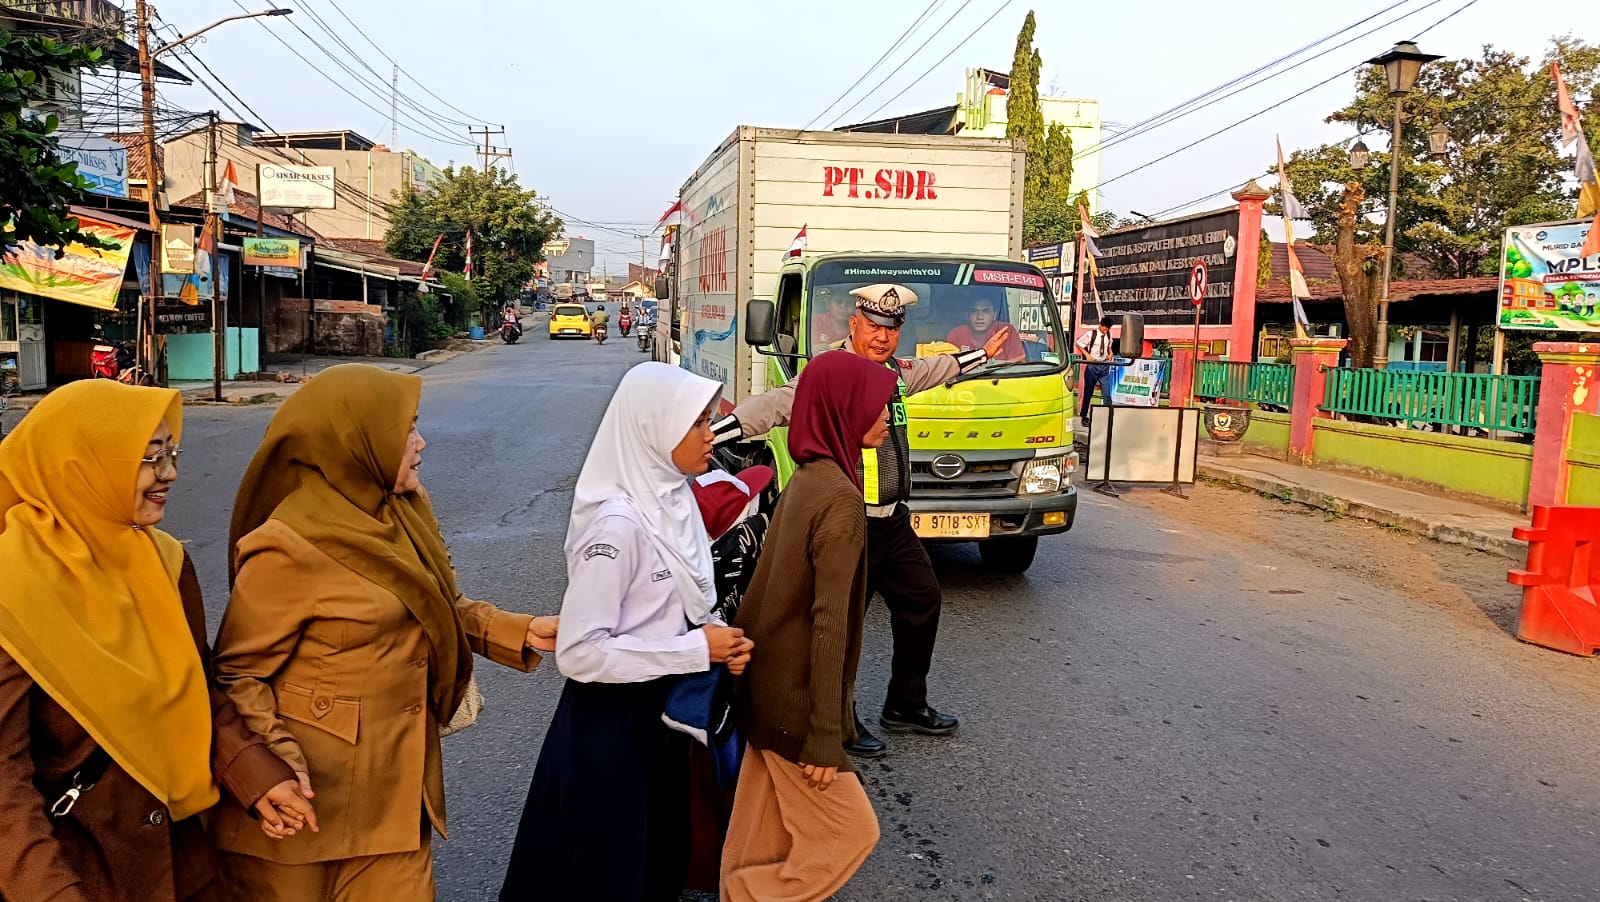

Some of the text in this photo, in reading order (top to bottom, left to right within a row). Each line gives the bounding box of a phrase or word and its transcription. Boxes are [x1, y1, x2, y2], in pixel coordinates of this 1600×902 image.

[822, 166, 938, 200] PT.SDR
[1542, 241, 1586, 251] MURID BA
[844, 268, 941, 277] #HinoAlwayswithYOU
[982, 271, 1037, 287] MSR-E141
[916, 430, 1003, 439] UTRO
[1024, 435, 1055, 444] 300
[913, 515, 988, 530] B 9718 SXT
